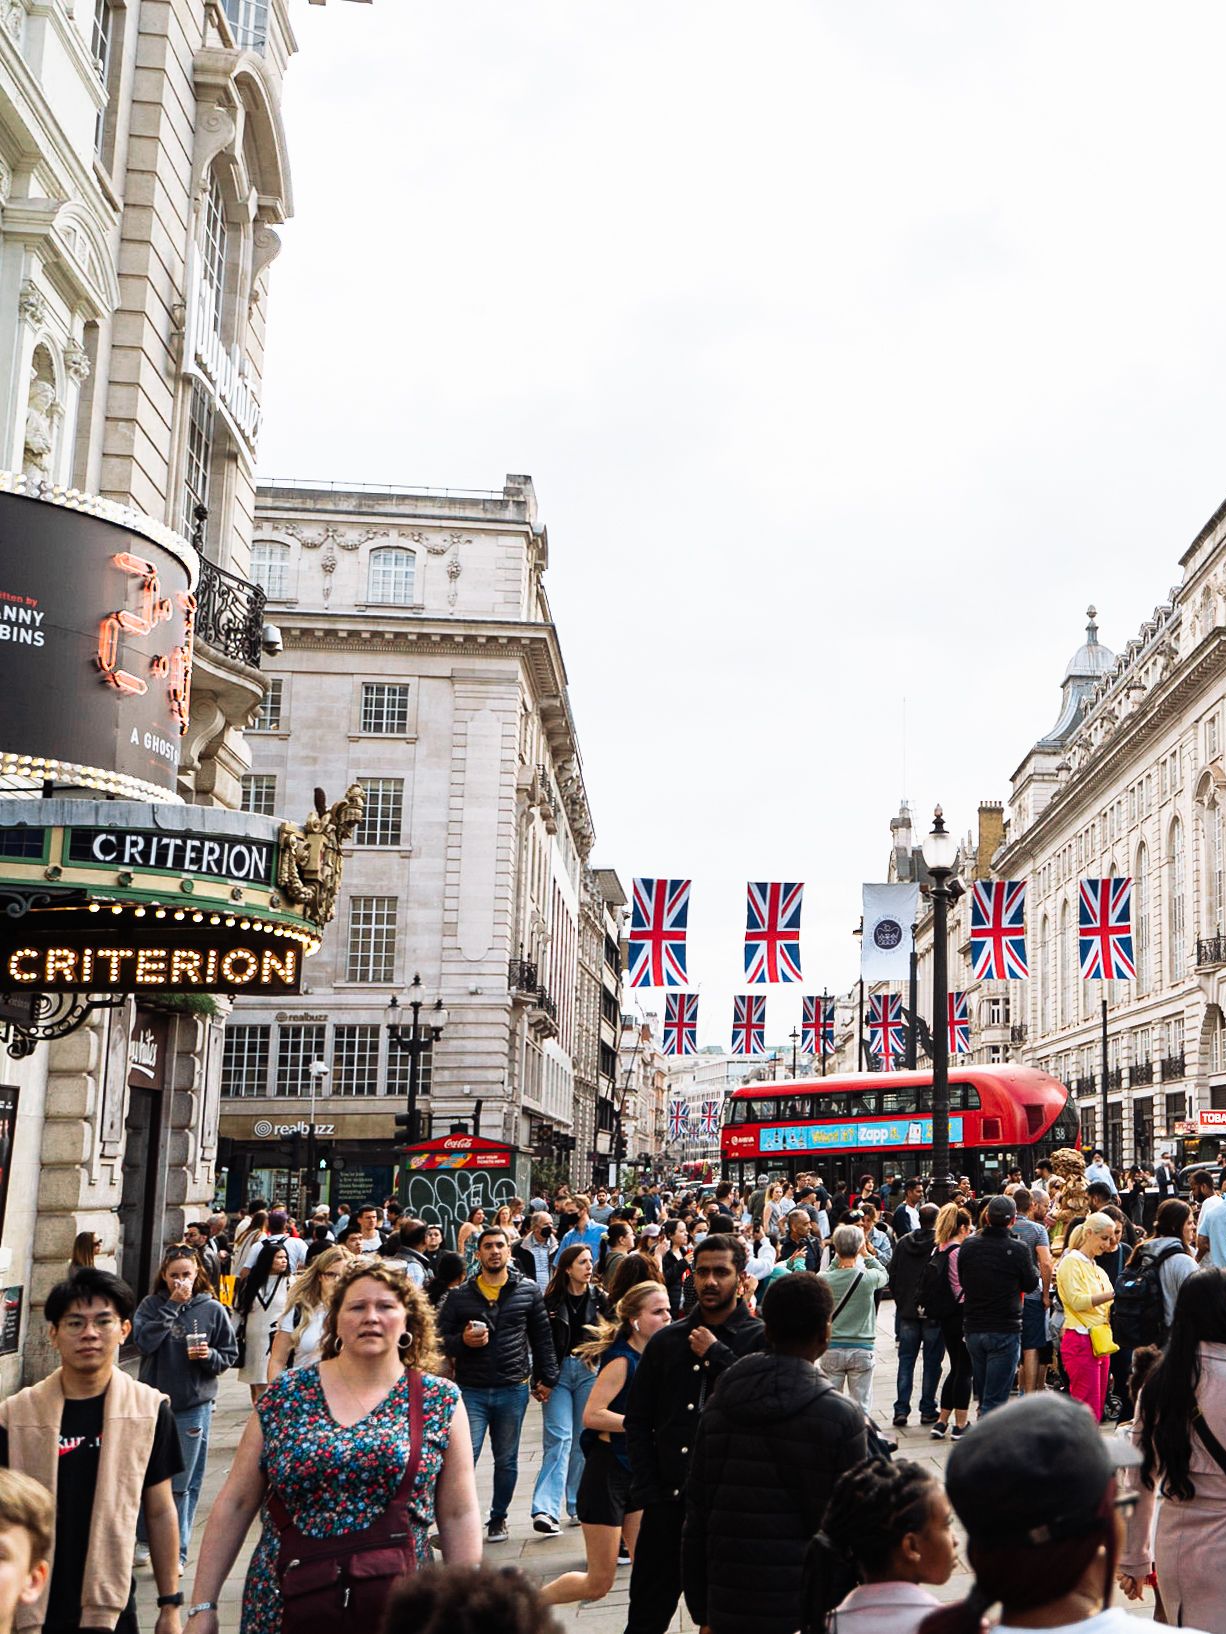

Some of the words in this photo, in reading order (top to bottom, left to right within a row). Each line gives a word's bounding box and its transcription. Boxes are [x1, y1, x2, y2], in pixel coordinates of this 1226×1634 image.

[0, 604, 45, 627] NNY
[130, 727, 140, 745] A
[92, 833, 267, 880] CRITERION
[8, 947, 298, 985] CRITERION
[288, 1012, 329, 1022] realbuzz
[860, 1126, 889, 1144] Zapp
[1055, 1127, 1066, 1140] 38
